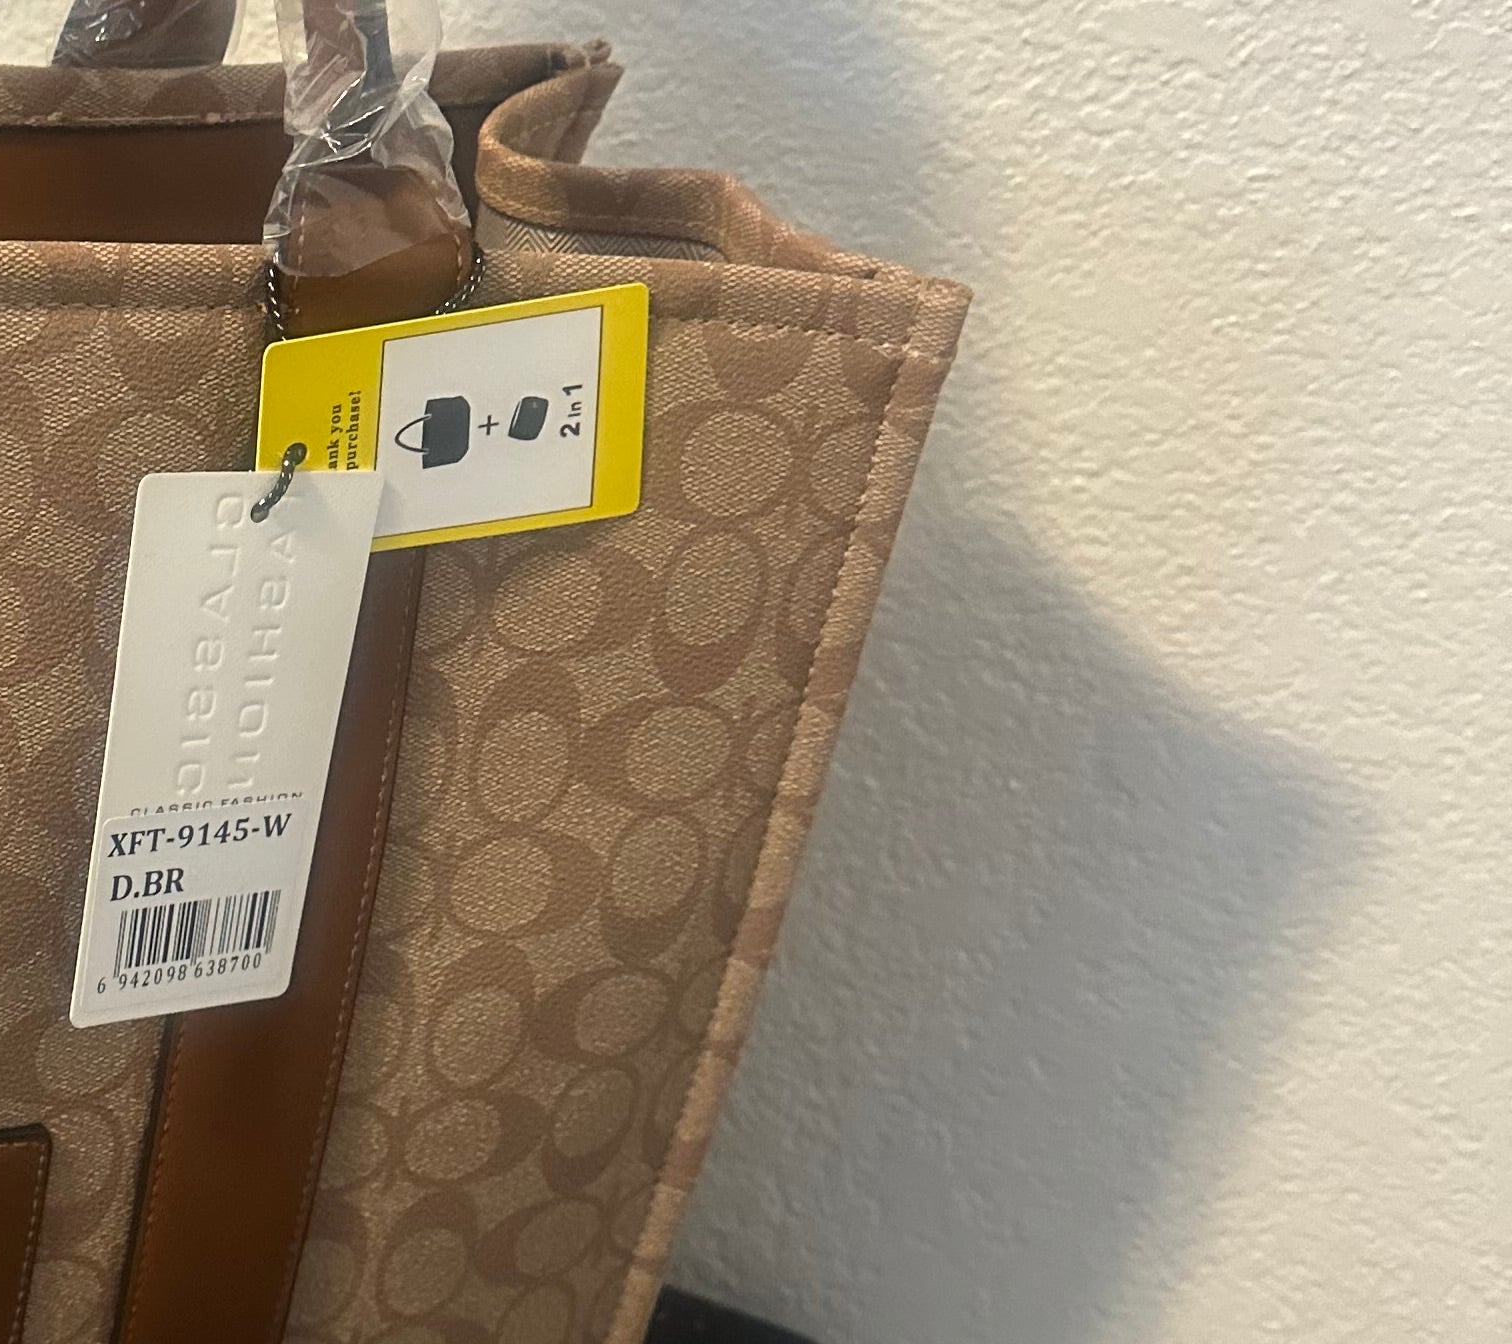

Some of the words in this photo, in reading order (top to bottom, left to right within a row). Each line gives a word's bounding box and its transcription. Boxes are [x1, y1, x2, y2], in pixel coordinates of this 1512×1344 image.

[562, 384, 583, 396] 1
[331, 404, 343, 434] you
[346, 390, 361, 470] purchase!
[560, 422, 580, 437] 2
[327, 439, 339, 469] ank
[108, 813, 292, 858] XFT-9145-W
[109, 867, 185, 901] D.BR
[97, 977, 106, 994] 6
[118, 964, 188, 990] 942098
[195, 952, 262, 979] 638700
